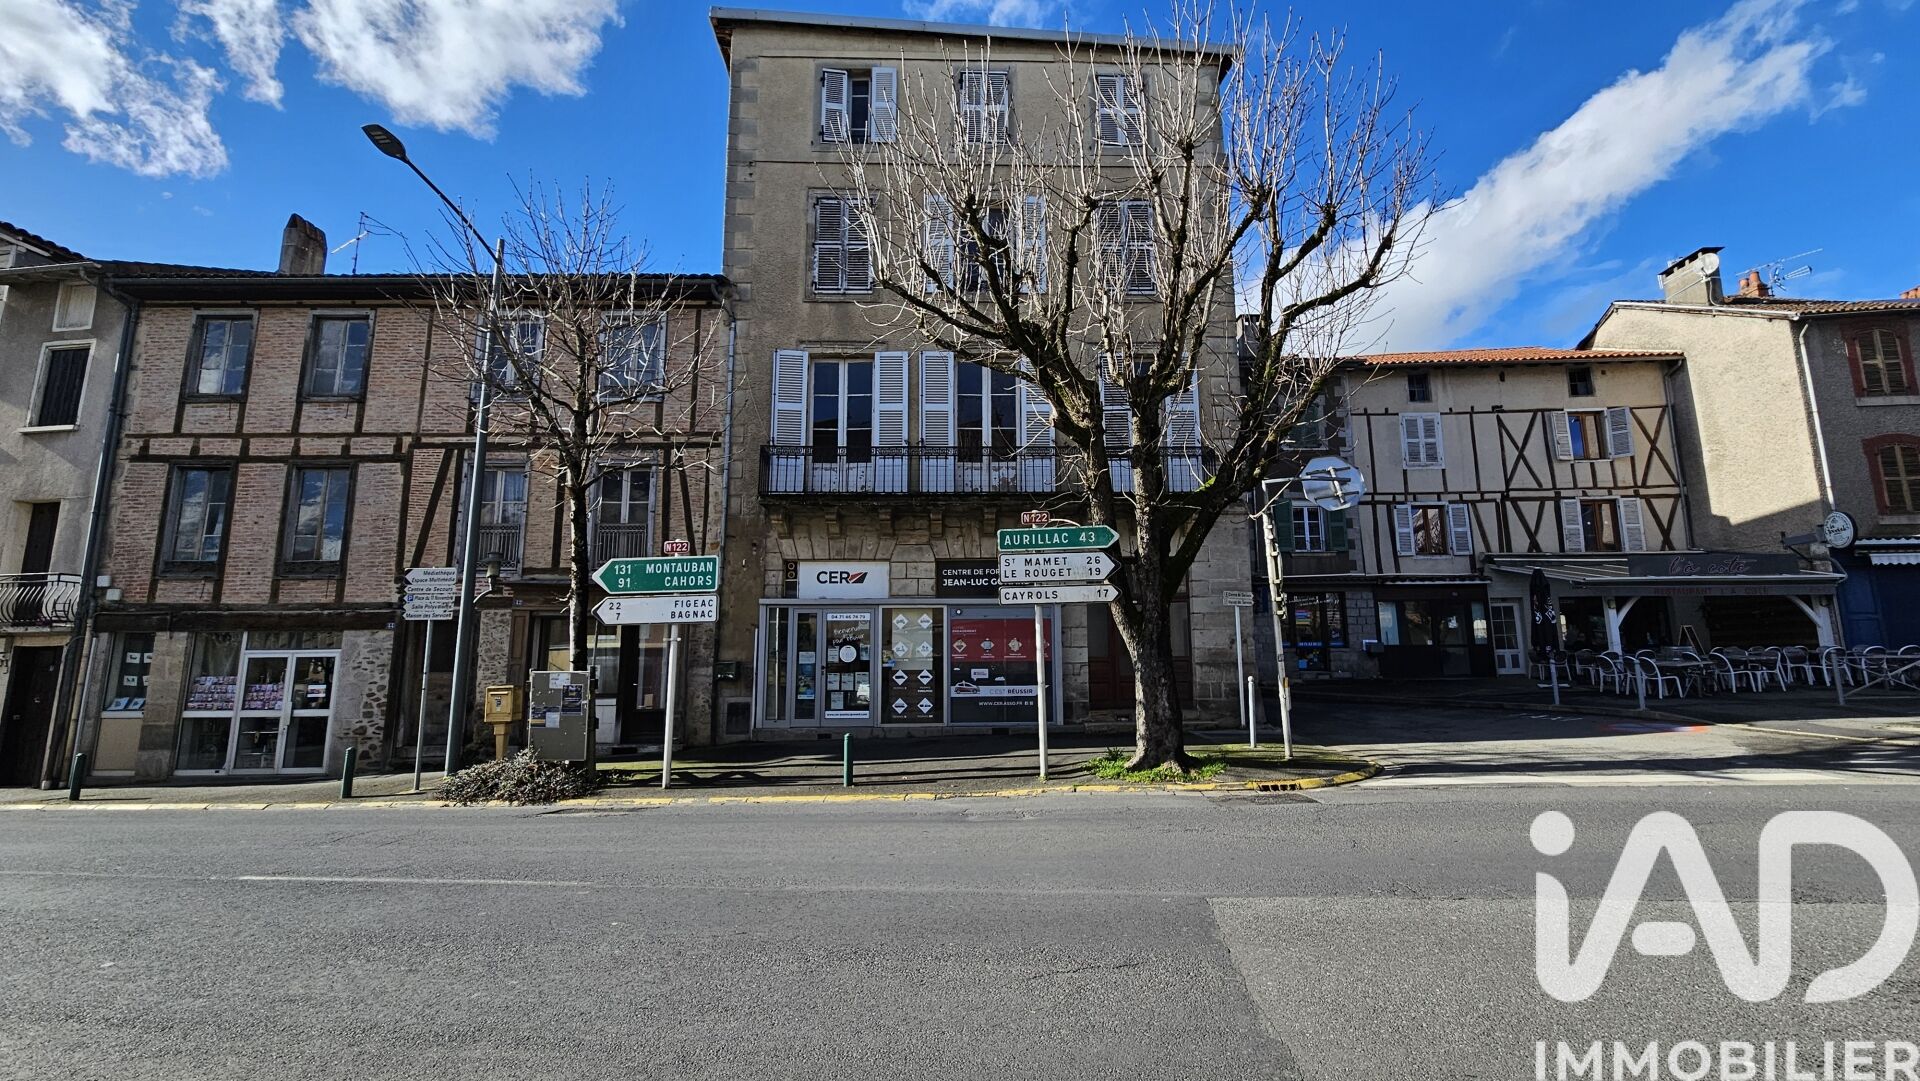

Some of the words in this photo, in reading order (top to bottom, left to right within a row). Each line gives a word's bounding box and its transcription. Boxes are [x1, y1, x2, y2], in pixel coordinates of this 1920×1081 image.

[1024, 513, 1048, 523] N122
[1004, 532, 1069, 546] AURILLAC
[1079, 531, 1096, 543] 43
[666, 543, 688, 552] N122
[1024, 556, 1068, 567] MAMET
[1086, 556, 1101, 565] 26
[614, 564, 631, 575] 131
[645, 561, 713, 574] MONTAUBAN
[942, 568, 971, 576] CENTRE
[1004, 569, 1017, 579] LE
[1024, 567, 1072, 577] ROUGET
[1089, 567, 1101, 576] 19
[618, 578, 631, 588] 91
[664, 575, 713, 587] CAHORS
[816, 570, 851, 584] CER
[942, 578, 989, 587] JEAN-LUC
[1004, 590, 1059, 601] CAYROLS
[1096, 589, 1109, 598] 17
[609, 602, 622, 610] 22
[674, 599, 714, 609] FIGEAC
[670, 609, 713, 619] BAGNAC
